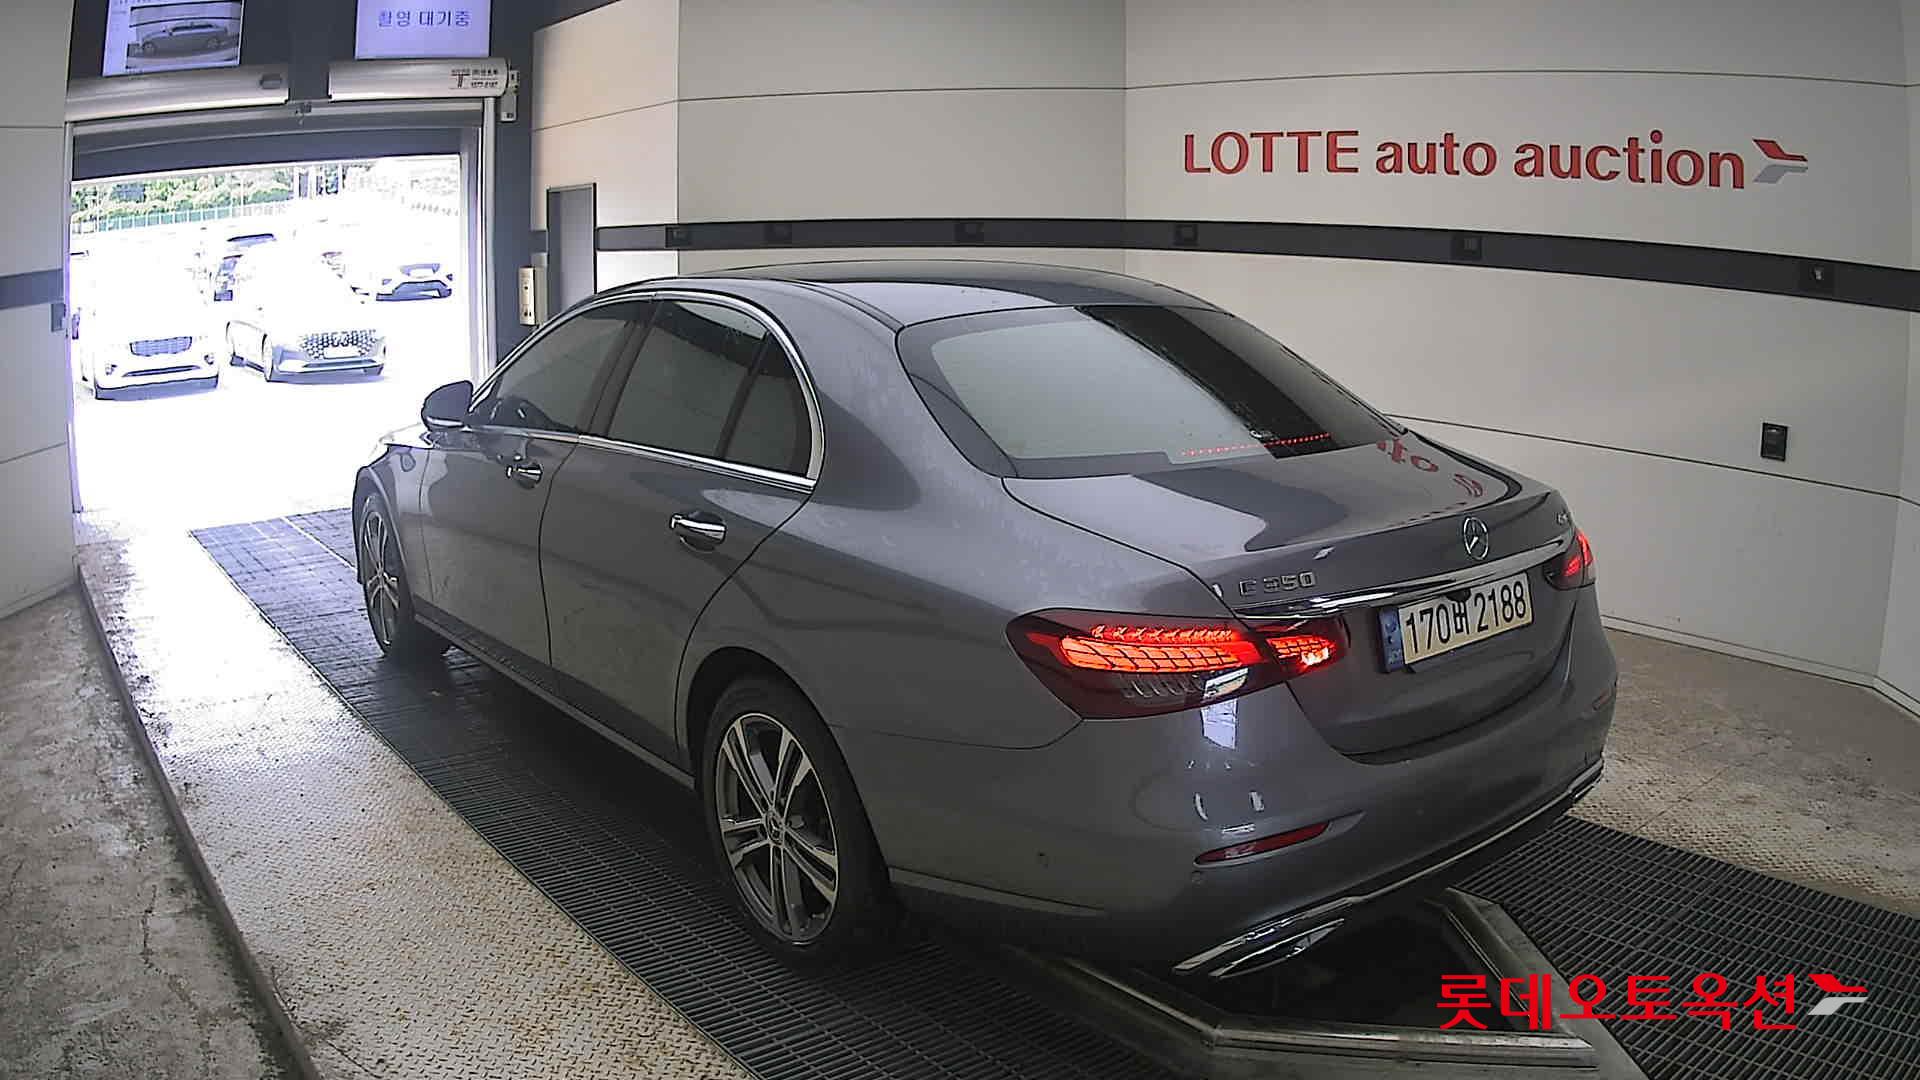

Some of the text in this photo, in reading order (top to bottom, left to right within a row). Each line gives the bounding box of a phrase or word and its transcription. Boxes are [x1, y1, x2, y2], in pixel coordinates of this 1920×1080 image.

[419, 9, 470, 27] 대기중
[1184, 129, 1746, 189] LOTTE auto auction
[1263, 571, 1316, 593] 350
[1474, 580, 1527, 633] 2188
